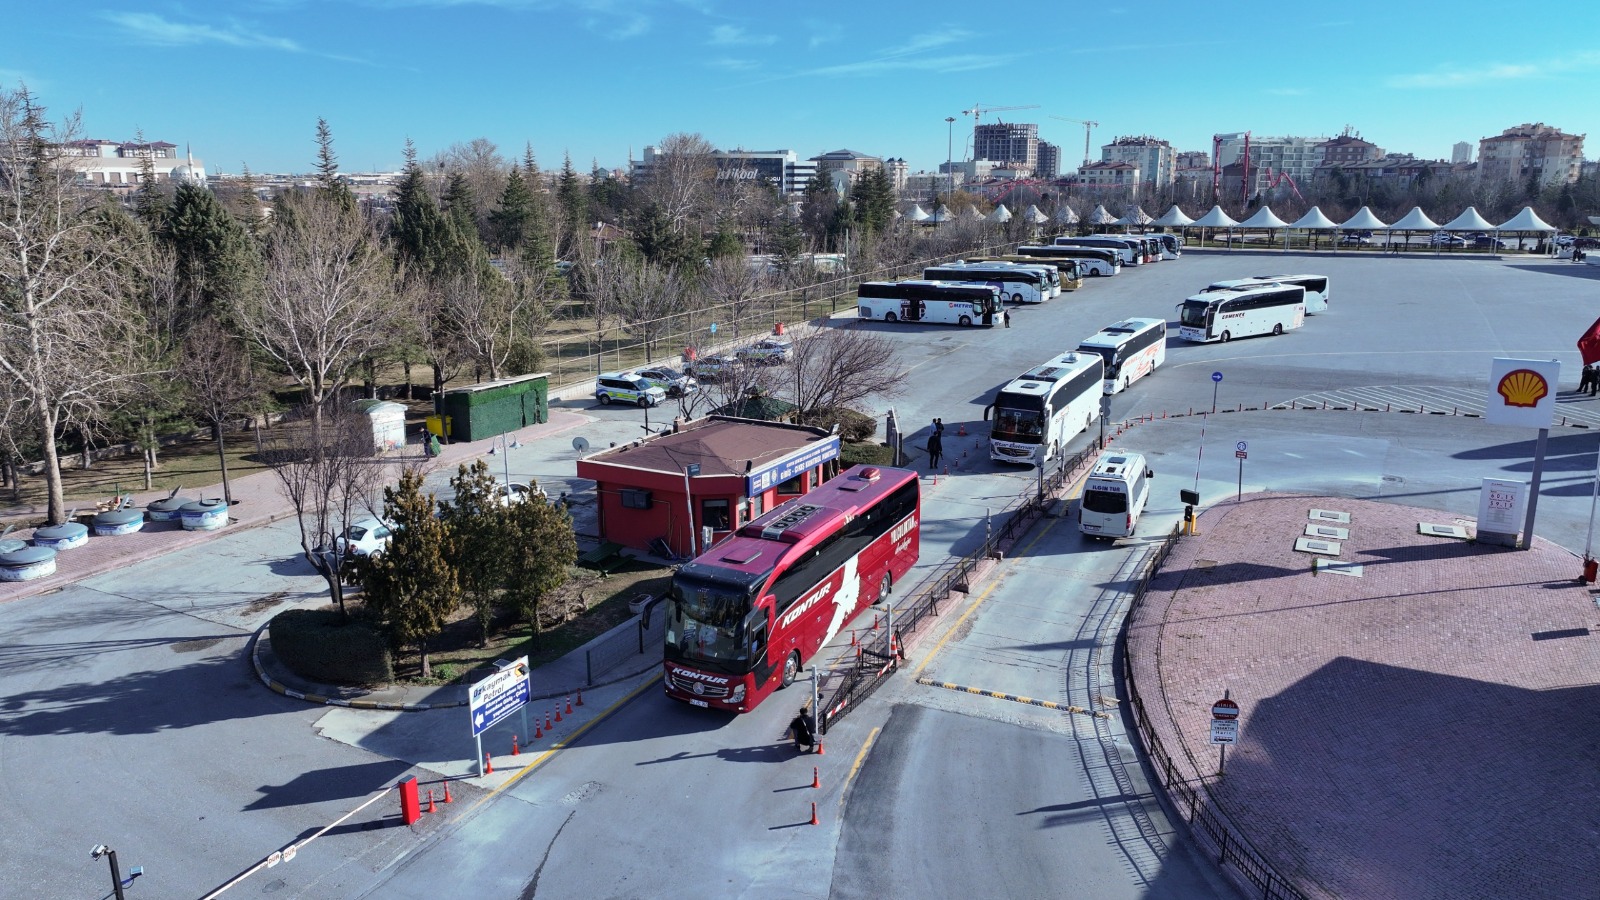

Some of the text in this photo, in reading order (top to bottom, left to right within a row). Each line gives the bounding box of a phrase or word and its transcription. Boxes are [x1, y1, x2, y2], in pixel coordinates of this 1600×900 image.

[781, 581, 832, 629] KONTUR
[672, 667, 729, 684] KONTUR
[483, 684, 504, 702] Petrol
[284, 847, 296, 858] DUR
